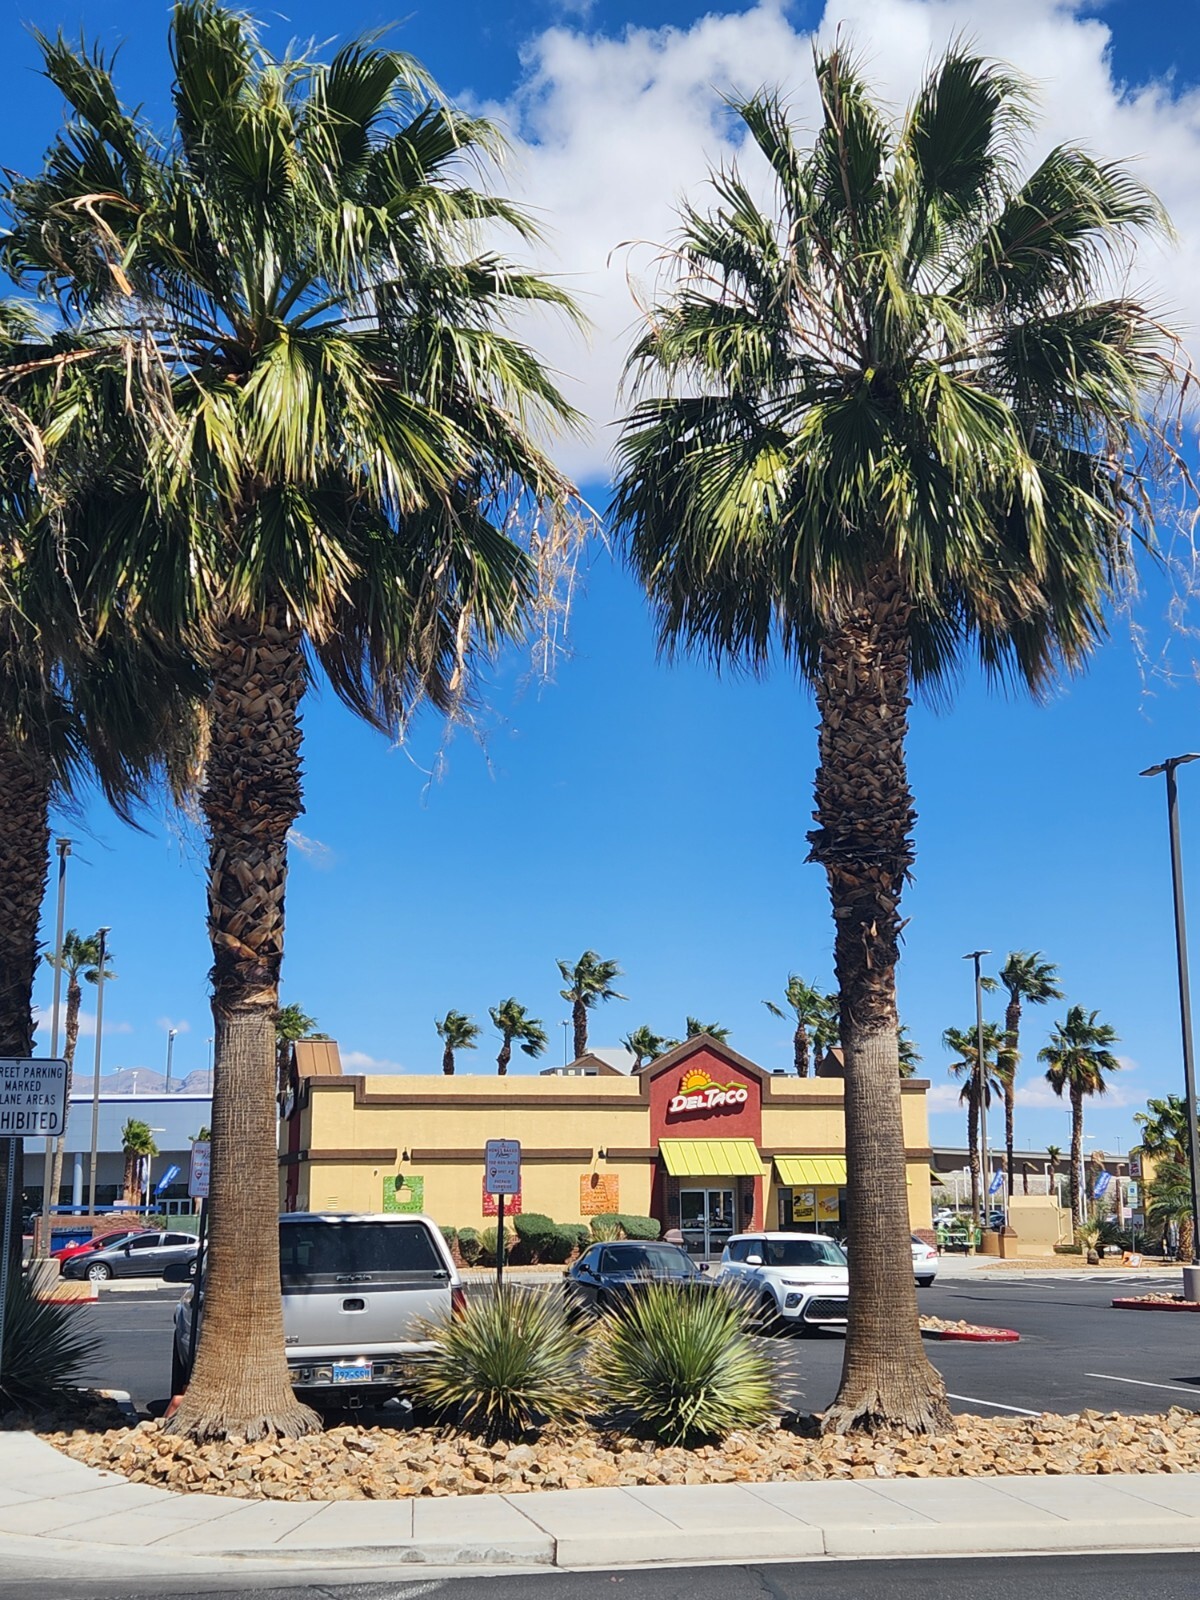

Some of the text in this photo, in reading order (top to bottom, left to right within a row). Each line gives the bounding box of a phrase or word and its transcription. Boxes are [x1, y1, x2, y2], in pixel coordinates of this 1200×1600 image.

[24, 1067, 63, 1079] PARKING
[4, 1080, 41, 1091] MARKED
[0, 1093, 56, 1105] LANE AREAS
